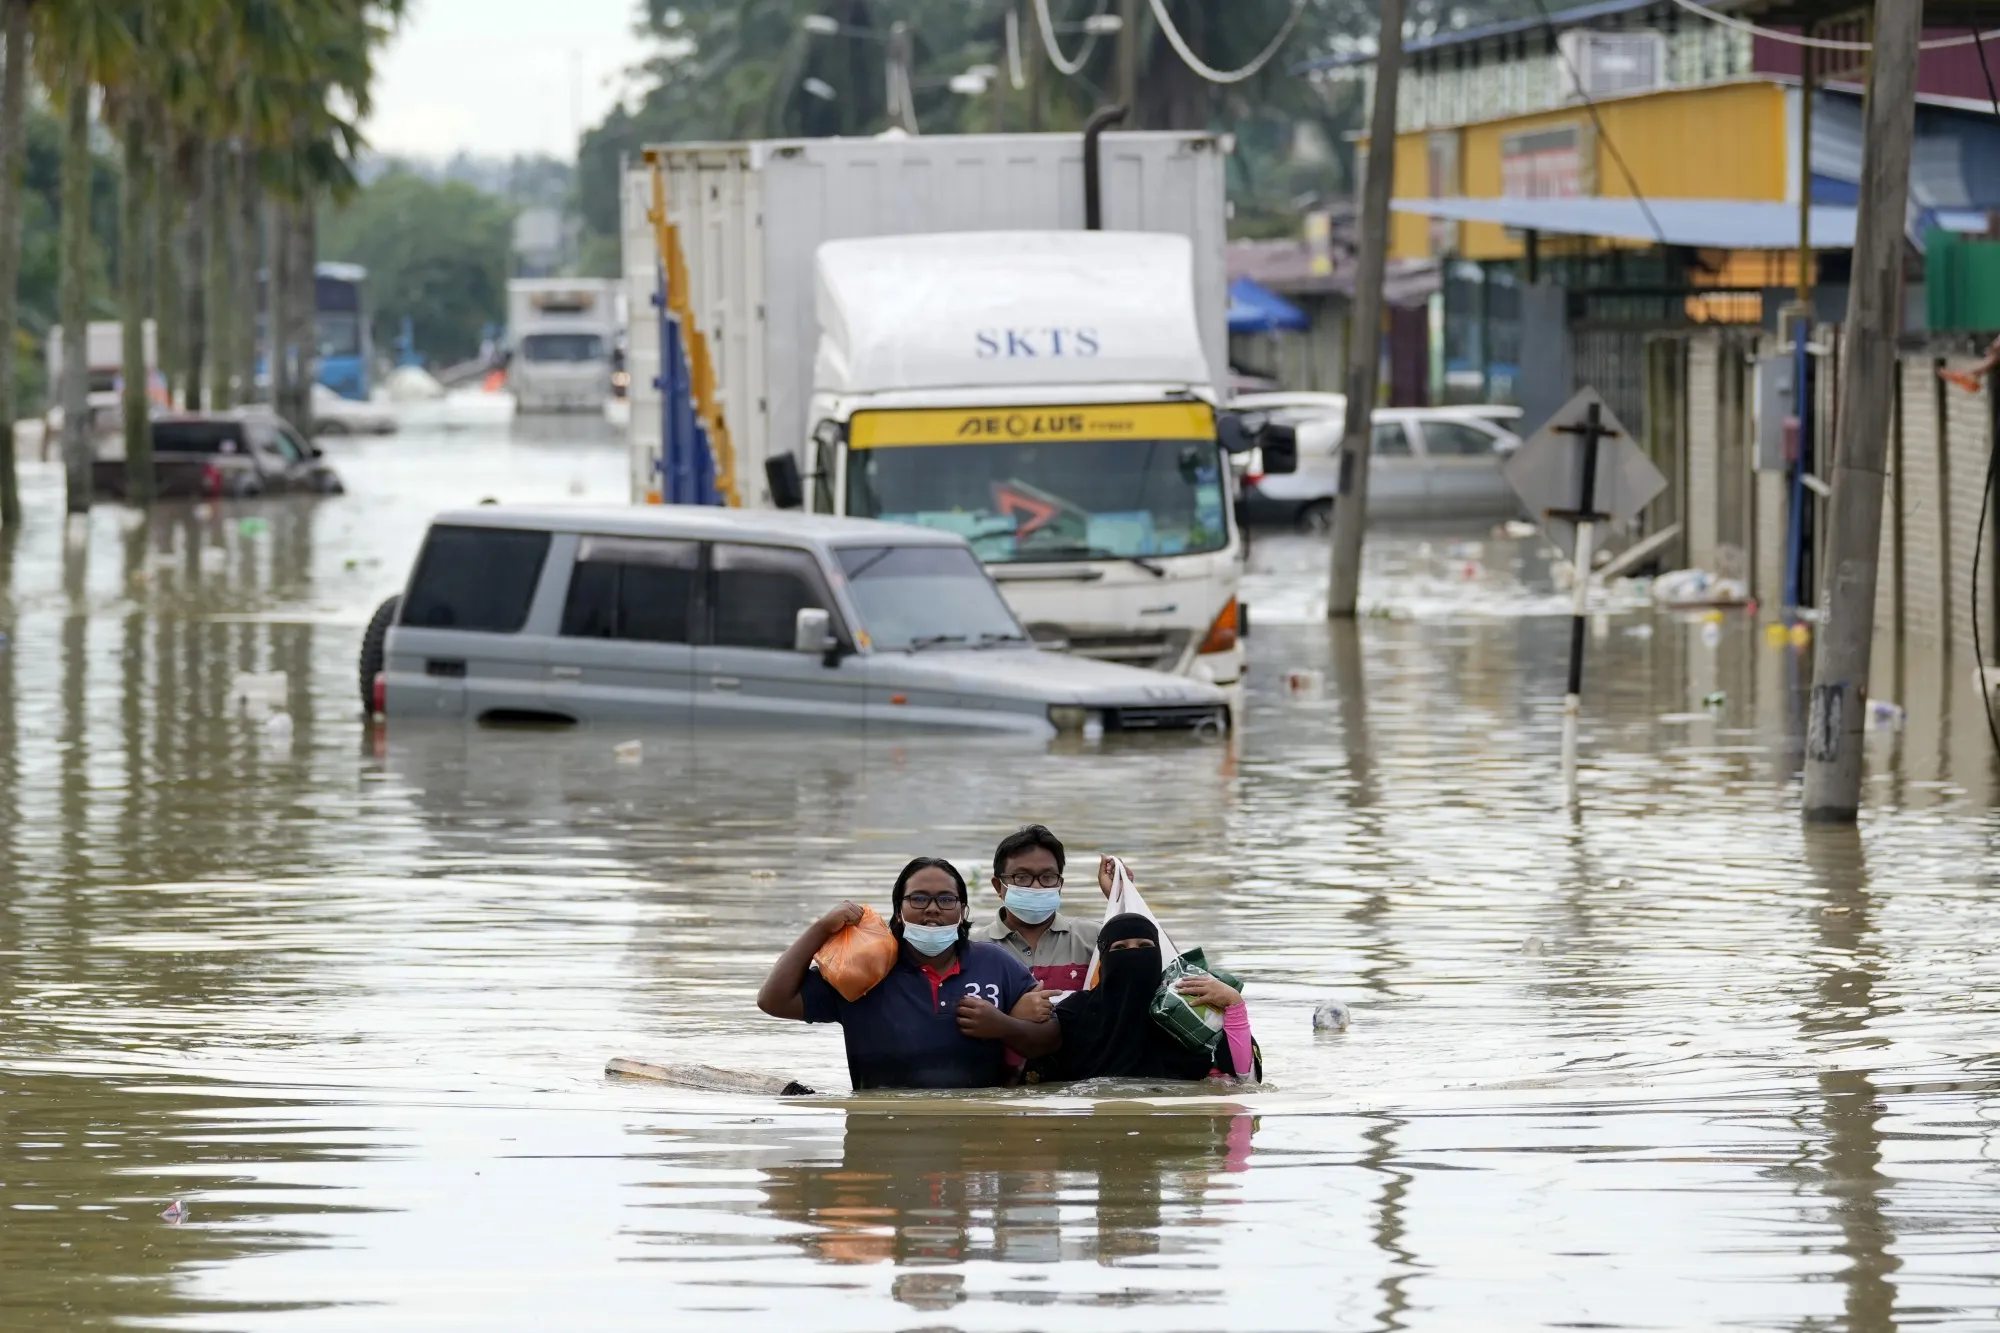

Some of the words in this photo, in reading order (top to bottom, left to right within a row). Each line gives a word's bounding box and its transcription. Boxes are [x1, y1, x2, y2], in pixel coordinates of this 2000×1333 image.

[975, 327, 1100, 359] SKTS
[958, 413, 1083, 437] AEOLUS
[964, 982, 1000, 1009] 33
